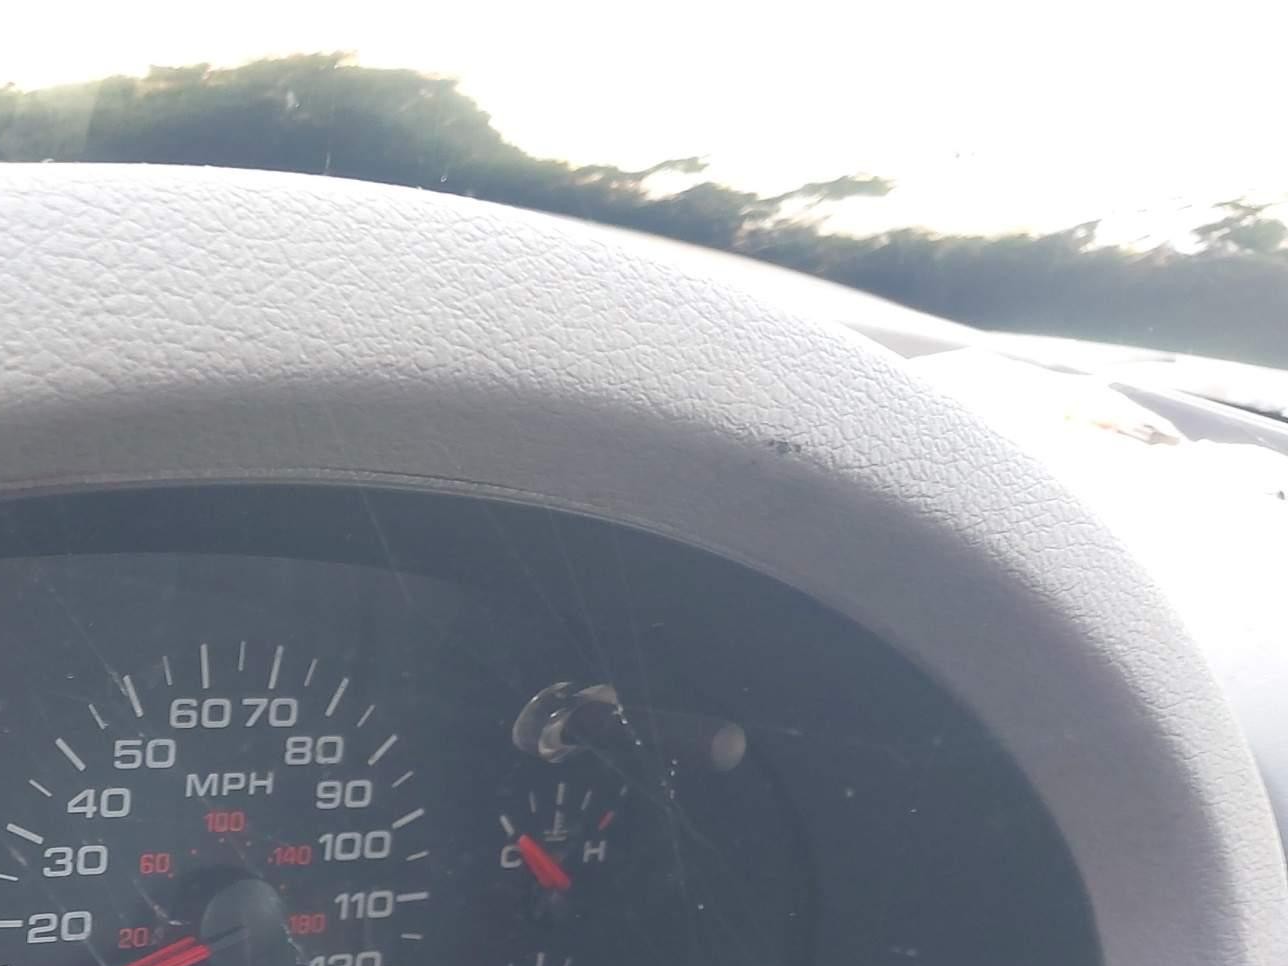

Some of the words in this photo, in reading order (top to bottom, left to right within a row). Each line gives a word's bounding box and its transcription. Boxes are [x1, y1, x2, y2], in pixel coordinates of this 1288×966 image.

[169, 698, 231, 728] 60
[242, 698, 298, 727] 70
[114, 738, 176, 769] 50
[284, 736, 344, 766] 80
[185, 772, 274, 797] MPH
[316, 780, 373, 809] 90
[67, 788, 131, 818] 40
[204, 811, 246, 833] 100
[273, 845, 312, 866] 140
[318, 831, 391, 861] 100
[500, 845, 523, 868] C
[583, 841, 607, 863] H
[42, 845, 108, 877] 30
[139, 853, 170, 874] 60
[334, 891, 394, 921] 110
[26, 911, 92, 943] 20
[118, 927, 148, 949] 20
